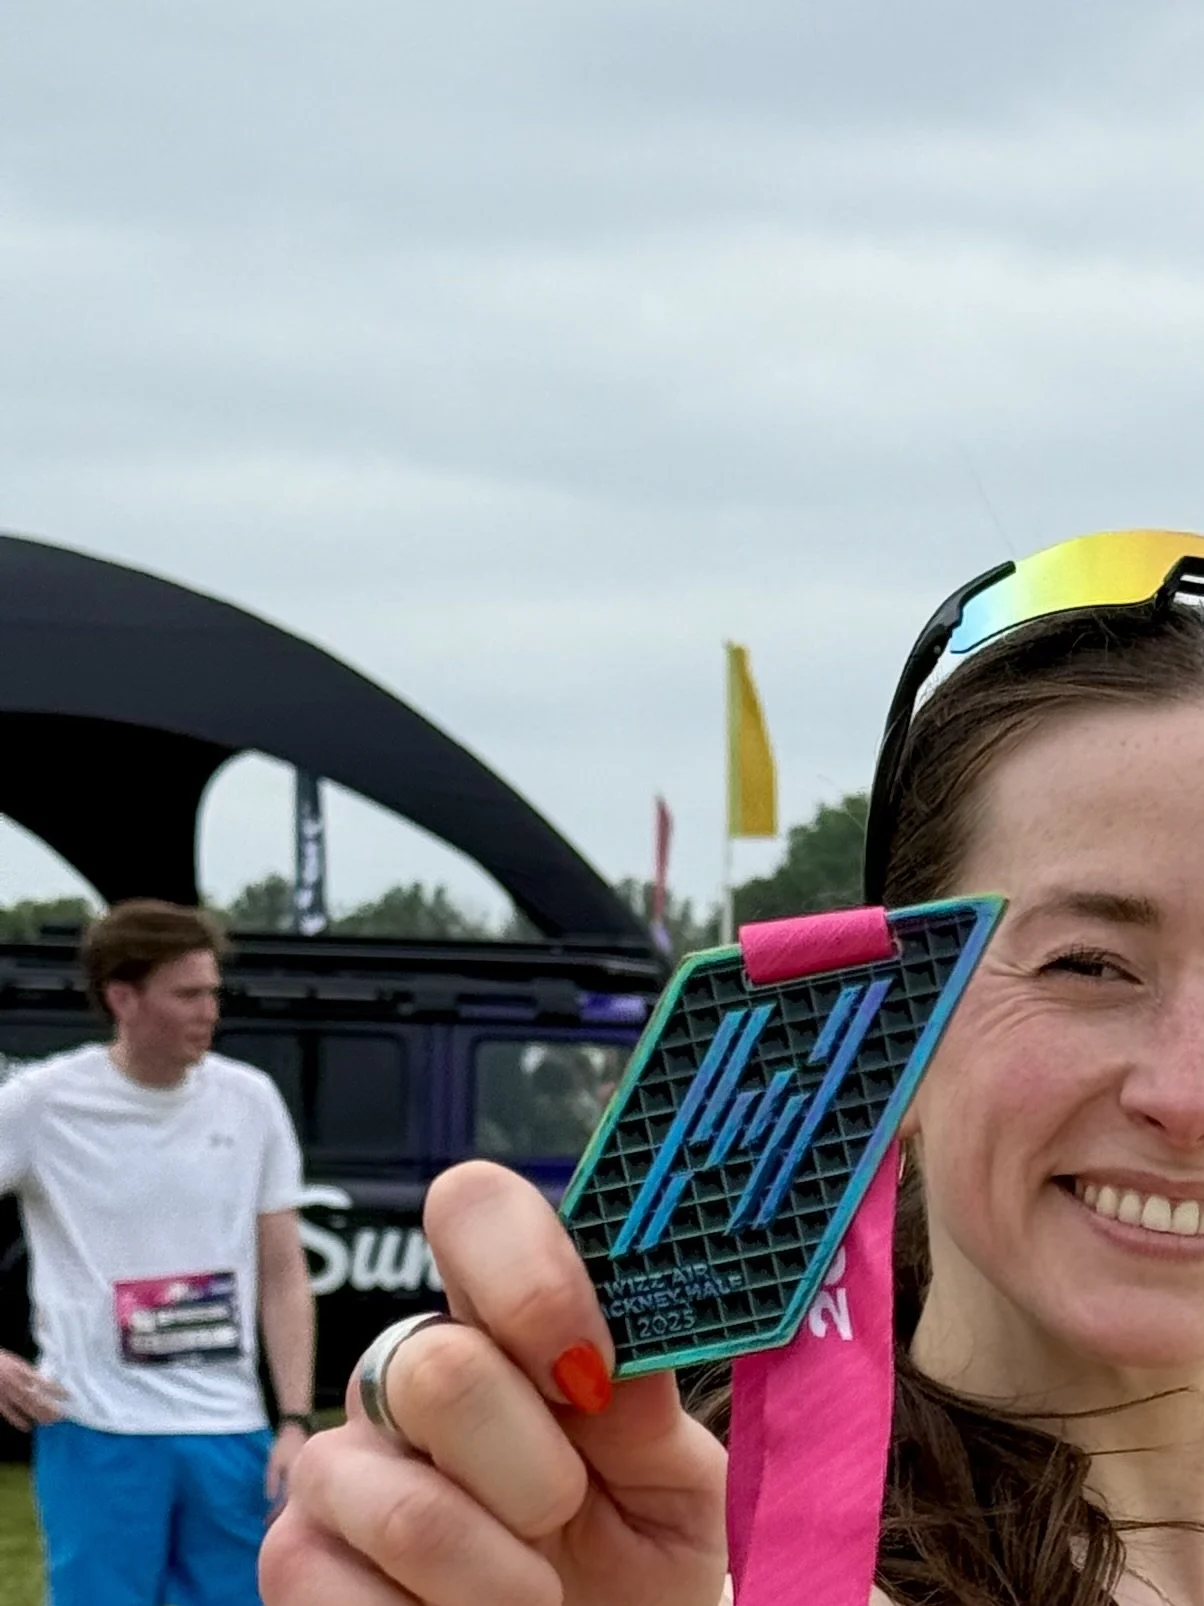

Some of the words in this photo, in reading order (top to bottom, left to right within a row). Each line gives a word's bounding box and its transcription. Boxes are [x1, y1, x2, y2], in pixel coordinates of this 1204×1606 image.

[604, 1274, 665, 1298] WIZZ
[672, 1263, 710, 1285] AIR
[685, 1275, 742, 1301] HALF
[638, 1309, 695, 1337] 2025
